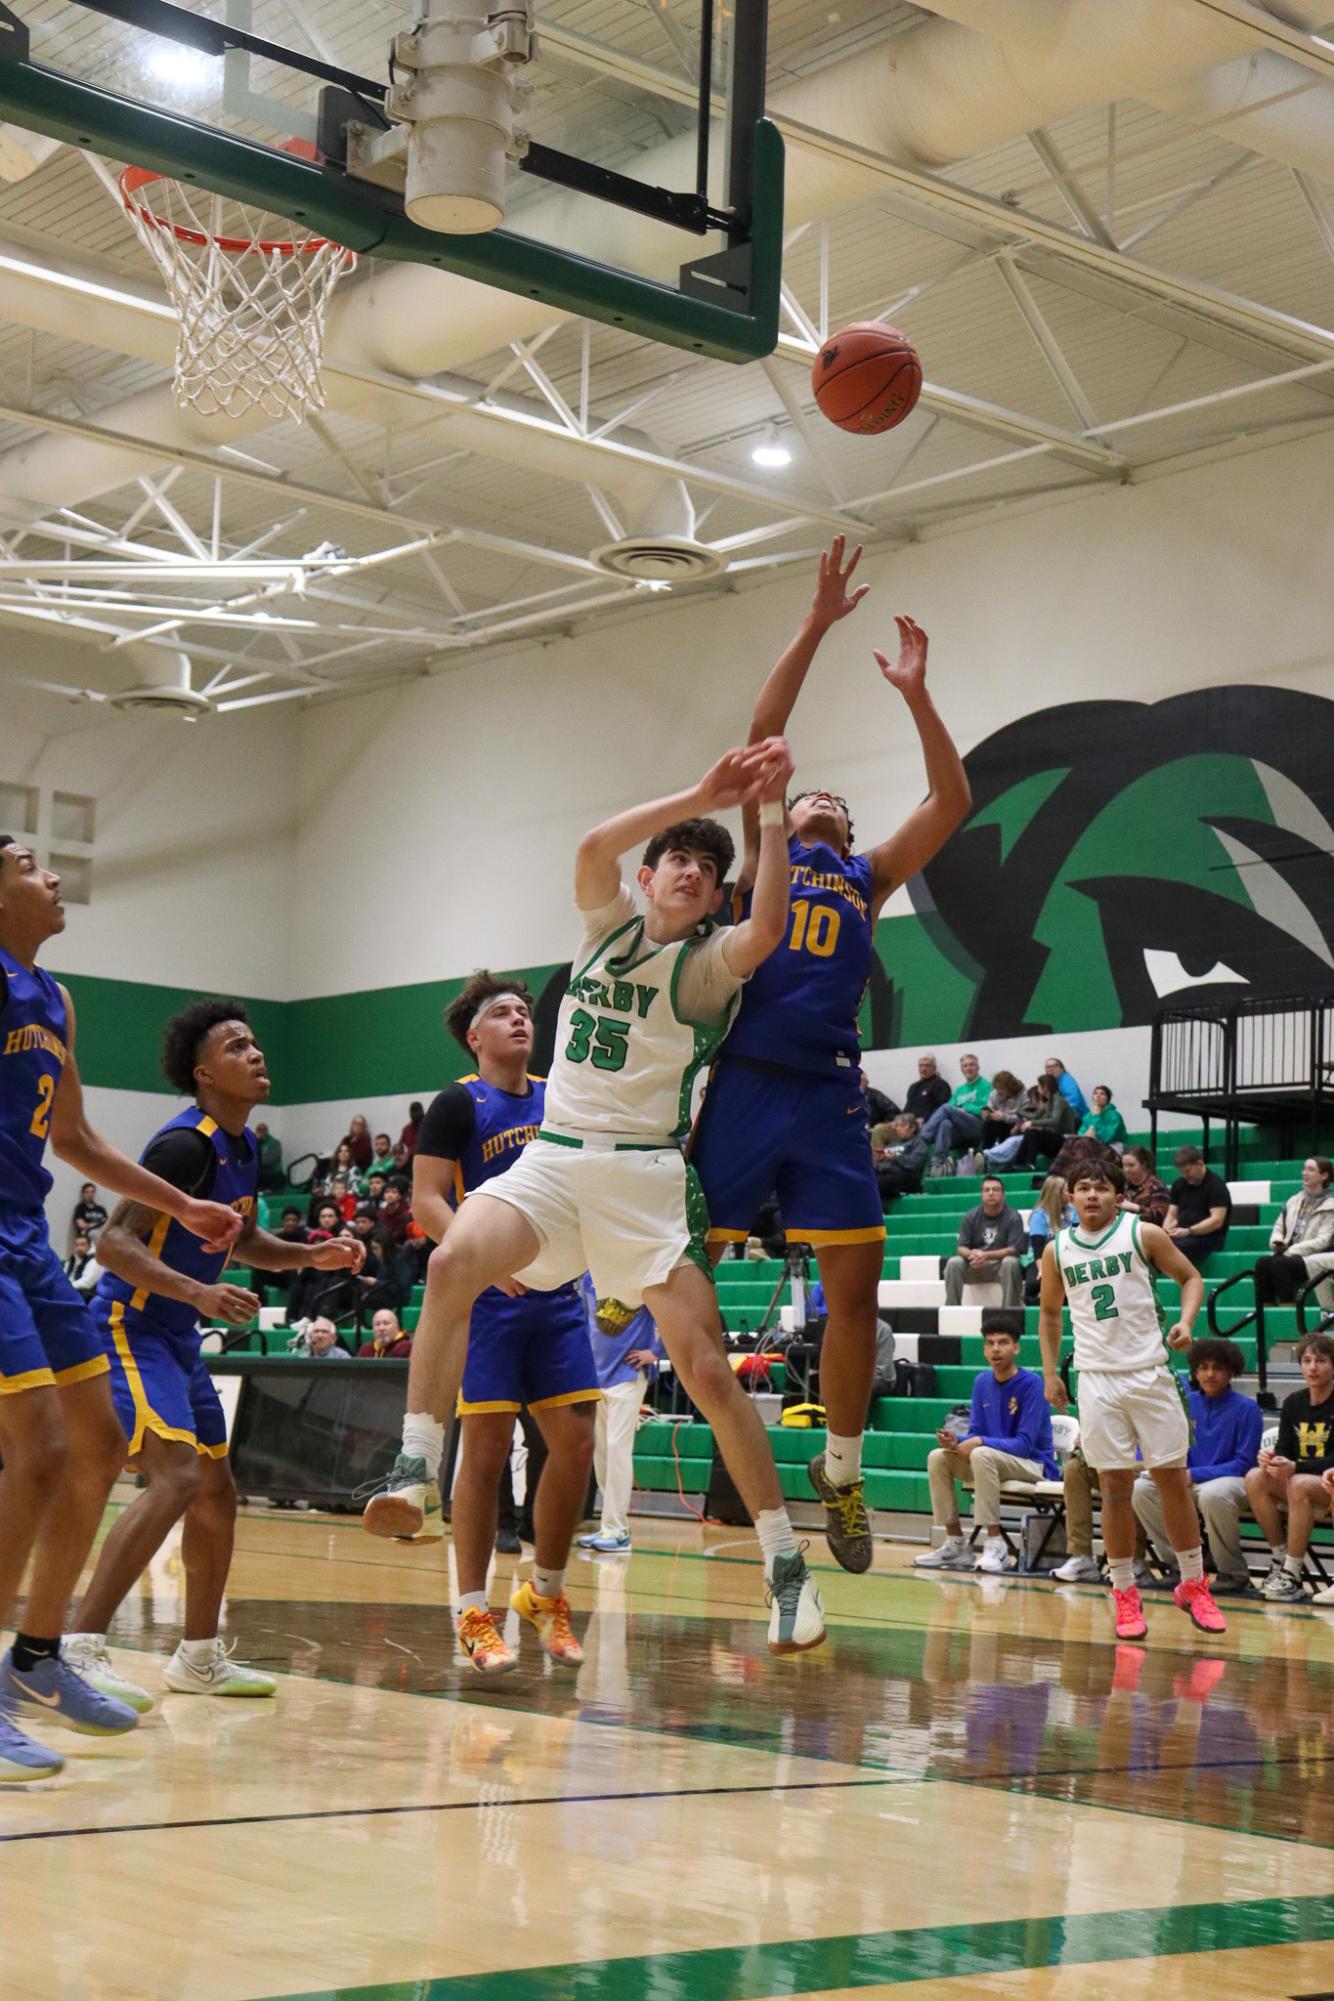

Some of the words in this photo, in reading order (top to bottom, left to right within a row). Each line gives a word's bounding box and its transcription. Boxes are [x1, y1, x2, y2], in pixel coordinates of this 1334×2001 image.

[790, 865, 868, 921] TCHINSON
[789, 899, 841, 957] 10
[565, 1008, 631, 1072] 35
[29, 1074, 54, 1139] 2
[1064, 1252, 1132, 1288] DERBY
[1091, 1284, 1119, 1320] 2
